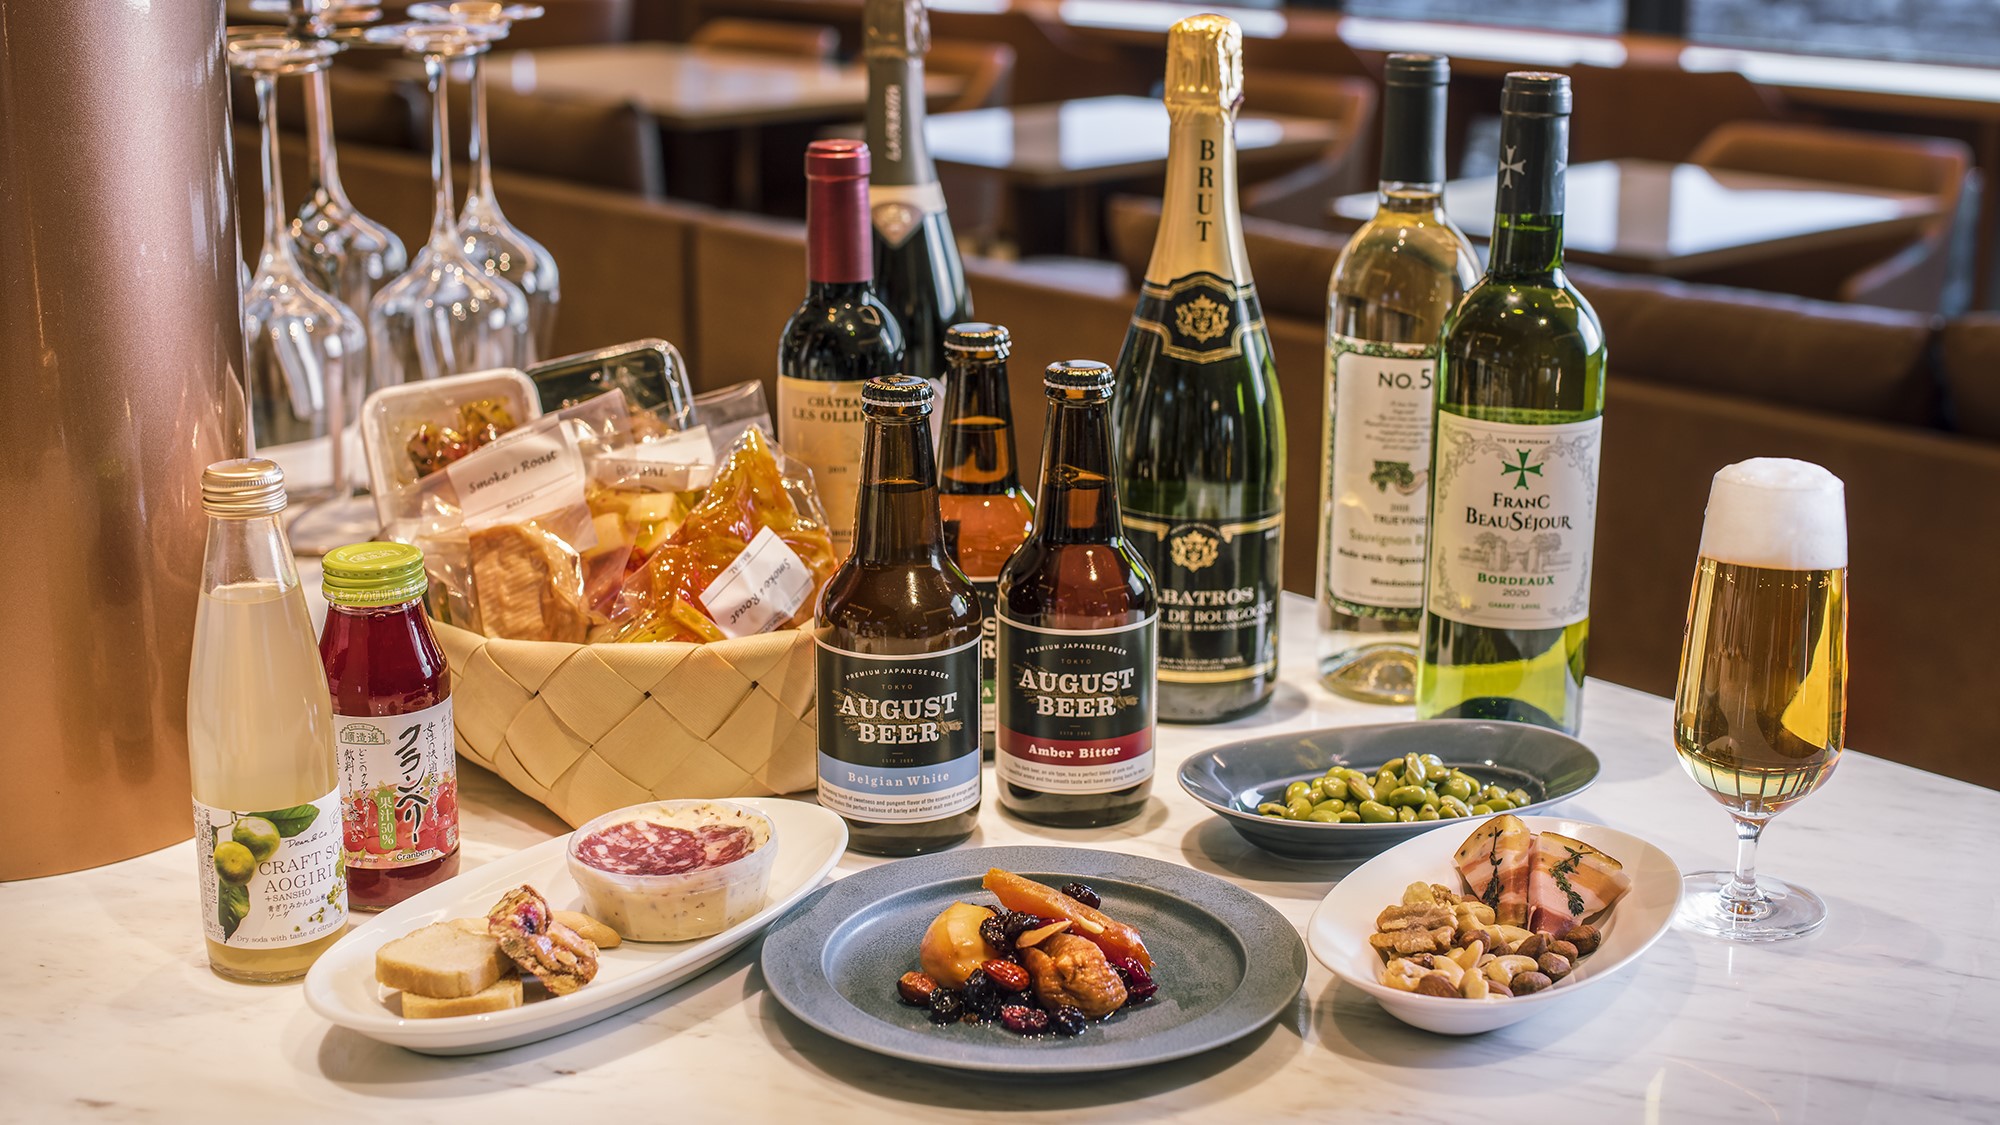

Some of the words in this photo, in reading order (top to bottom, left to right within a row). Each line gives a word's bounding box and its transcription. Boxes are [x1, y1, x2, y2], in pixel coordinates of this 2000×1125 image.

[1196, 139, 1215, 242] BRUT
[792, 407, 816, 422] LES
[468, 468, 511, 495] Smoke
[520, 450, 559, 473] Roast
[1349, 528, 1412, 548] Sauvignon
[762, 557, 791, 588] Smoke
[1477, 572, 1555, 586] BORDEAUX
[1157, 586, 1254, 606] BATROS
[1502, 588, 1530, 597] 2020
[730, 593, 761, 625] Roast
[1168, 609, 1190, 623] DE
[1026, 644, 1060, 655] PREMIUM
[1063, 643, 1106, 651] JAPANESE
[1108, 646, 1127, 656] BEER
[845, 669, 880, 681] PREMIUM
[883, 668, 928, 676] JAPANESE
[930, 670, 950, 680] BEER
[1018, 667, 1135, 693] AUGUST
[839, 692, 958, 720] AUGUST
[1036, 695, 1117, 718] BEER
[344, 731, 379, 743] 順造選
[858, 722, 940, 744] BEER
[1028, 744, 1074, 759] Amber
[1079, 746, 1121, 760] Bitter
[394, 723, 430, 844] クランベリー
[847, 771, 904, 788] Belgian
[907, 772, 950, 787] White
[258, 850, 321, 876] CRAFT
[396, 846, 436, 861] Cranberry
[264, 864, 332, 894] AOGIRI
[268, 910, 290, 920] ソーダ
[236, 934, 250, 943] Dry
[251, 935, 269, 943] soda
[270, 933, 288, 942] with
[289, 930, 308, 940] taste
[308, 927, 316, 935] of
[317, 922, 333, 933] citrus
